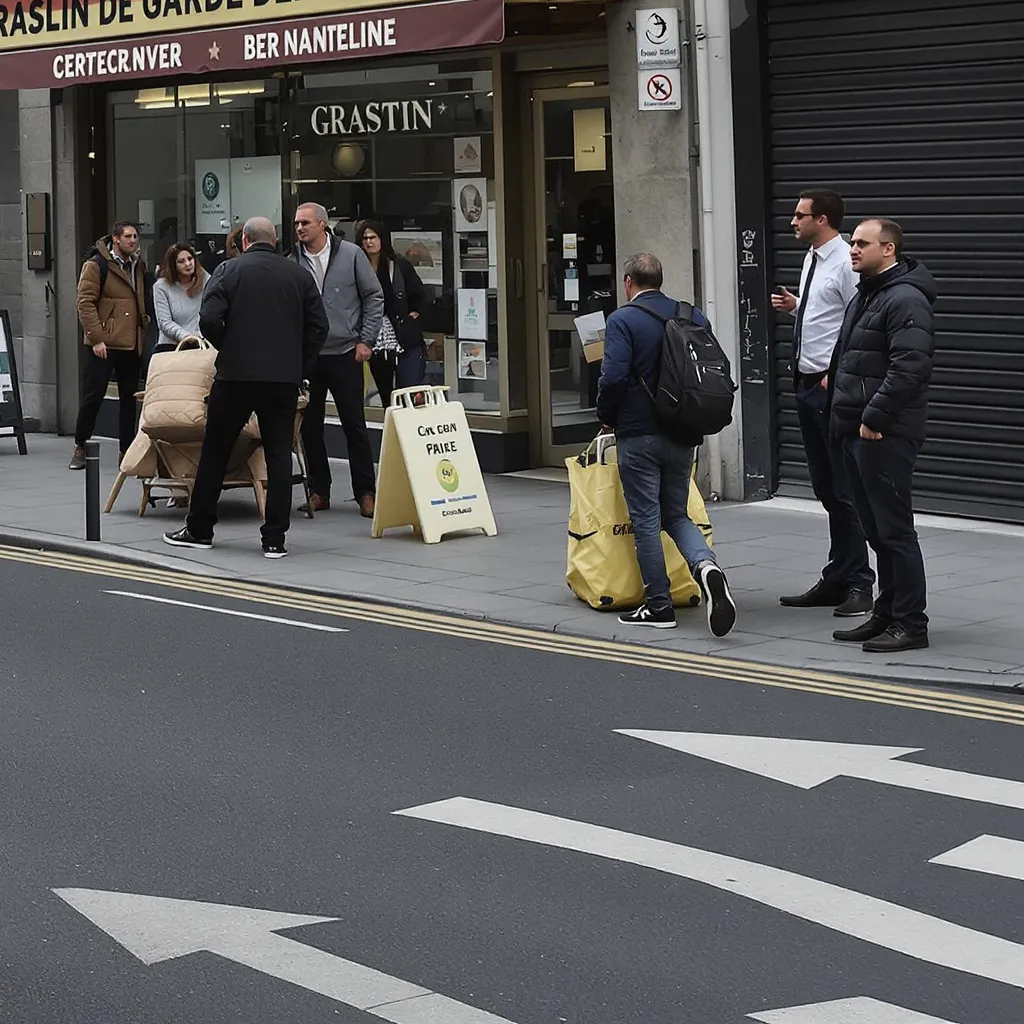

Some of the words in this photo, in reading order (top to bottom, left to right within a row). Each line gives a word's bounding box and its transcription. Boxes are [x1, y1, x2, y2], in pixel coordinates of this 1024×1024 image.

[244, 31, 280, 60] BER
[284, 17, 397, 56] NANTELINE
[310, 98, 433, 136] GRASTIN
